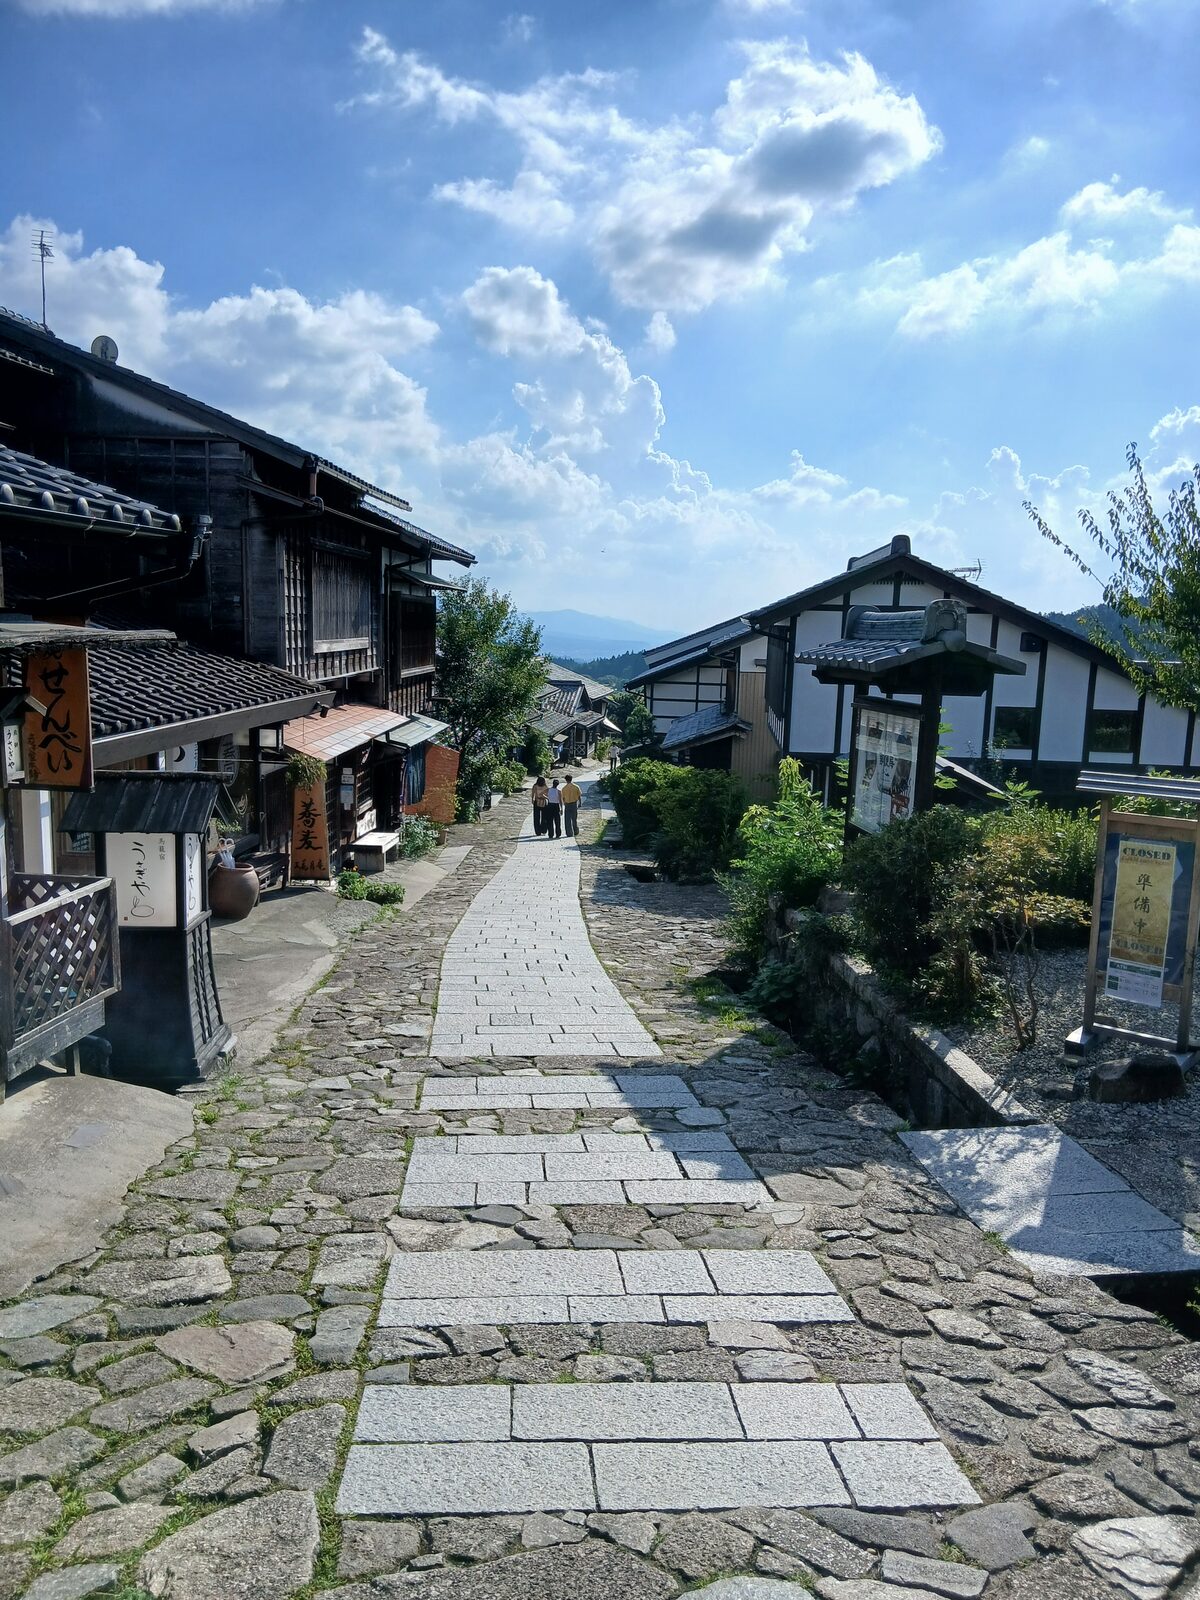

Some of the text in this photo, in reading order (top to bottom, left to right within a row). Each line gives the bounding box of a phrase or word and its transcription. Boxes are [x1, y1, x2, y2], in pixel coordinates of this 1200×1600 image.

[6, 728, 15, 769] うさぎや
[297, 797, 324, 851] 蕎麦
[130, 841, 151, 898] うさぎや
[1122, 847, 1172, 861] CLOSED
[1133, 873, 1153, 935] 準備中
